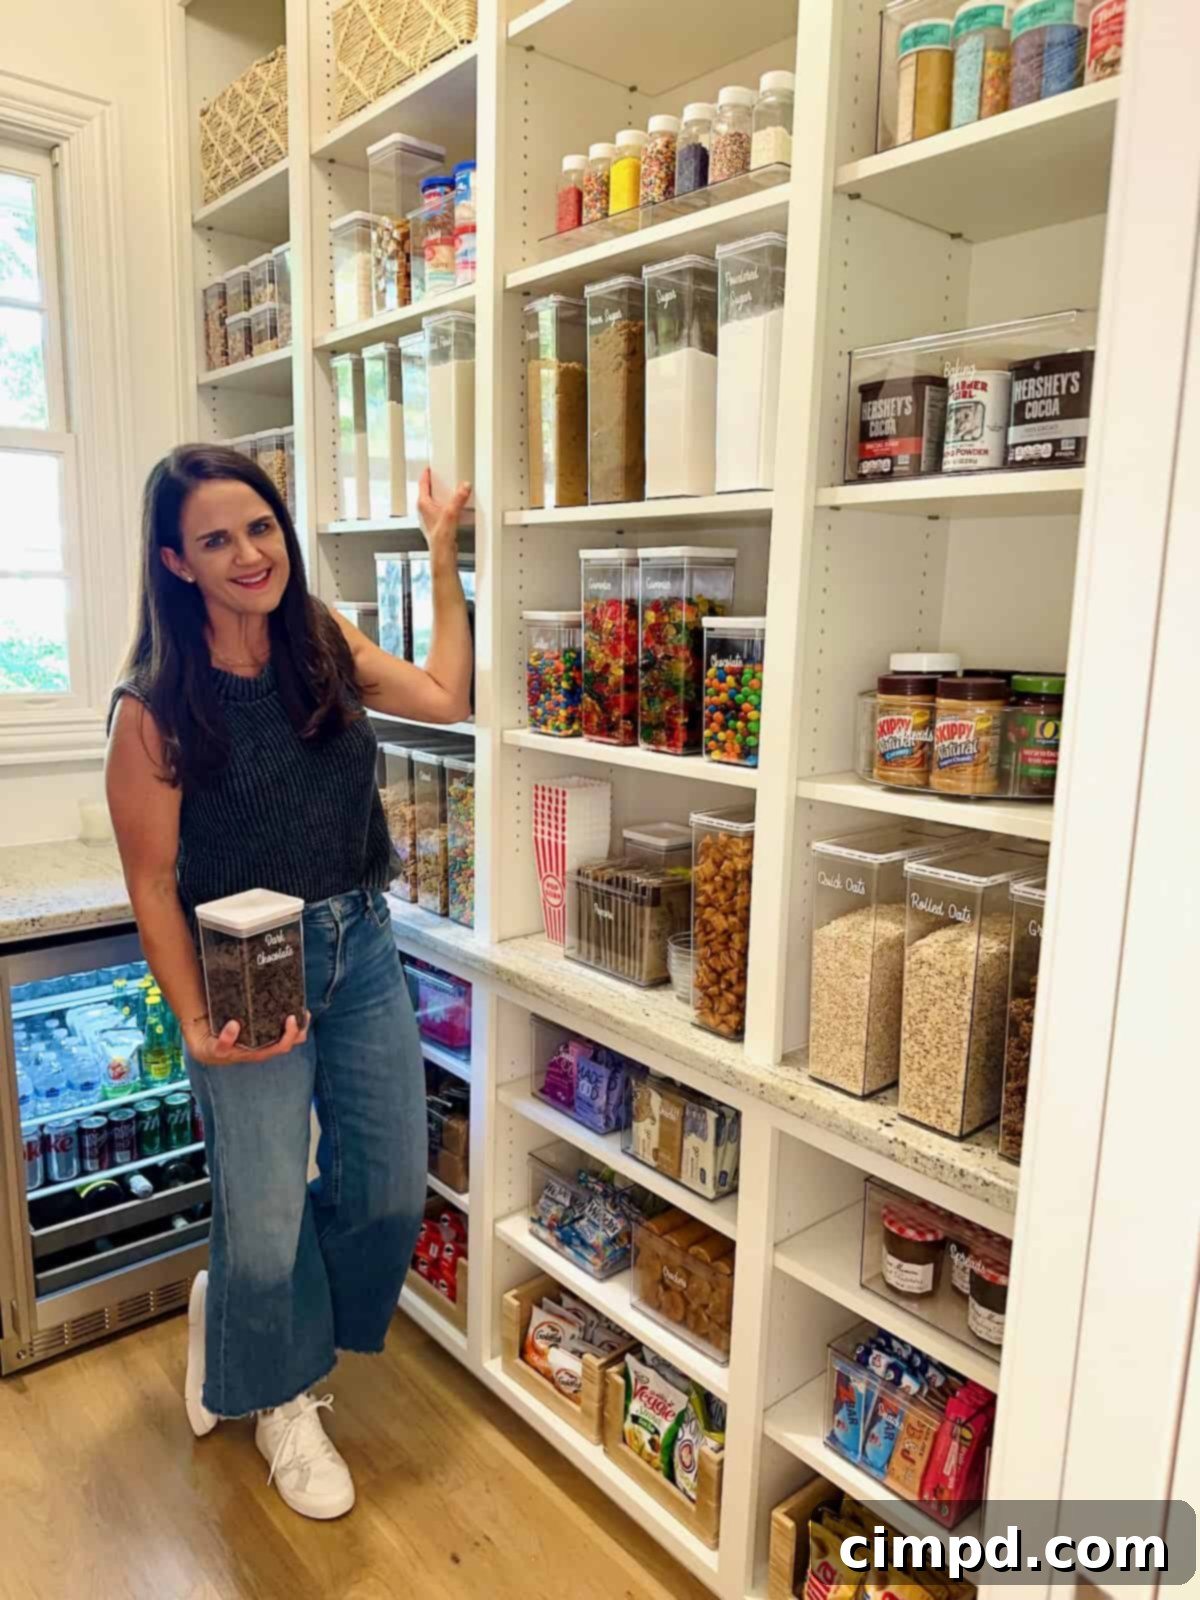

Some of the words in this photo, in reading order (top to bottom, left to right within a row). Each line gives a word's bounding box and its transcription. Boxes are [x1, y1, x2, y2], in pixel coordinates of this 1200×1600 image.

[1013, 371, 1081, 404] HERSHEY'S
[862, 395, 912, 420] HERSHEY'S
[1025, 398, 1060, 419] COCOA
[877, 718, 912, 738] SKIPPY
[935, 723, 973, 744] SKIPPY
[938, 738, 979, 759] Natural
[818, 872, 842, 889] Quick
[846, 878, 866, 896] Oats
[911, 892, 945, 916] Rolled
[948, 902, 972, 923] Oats
[264, 929, 285, 947] Dark
[256, 944, 294, 966] Chocolate
[633, 1377, 676, 1421] Veggie
